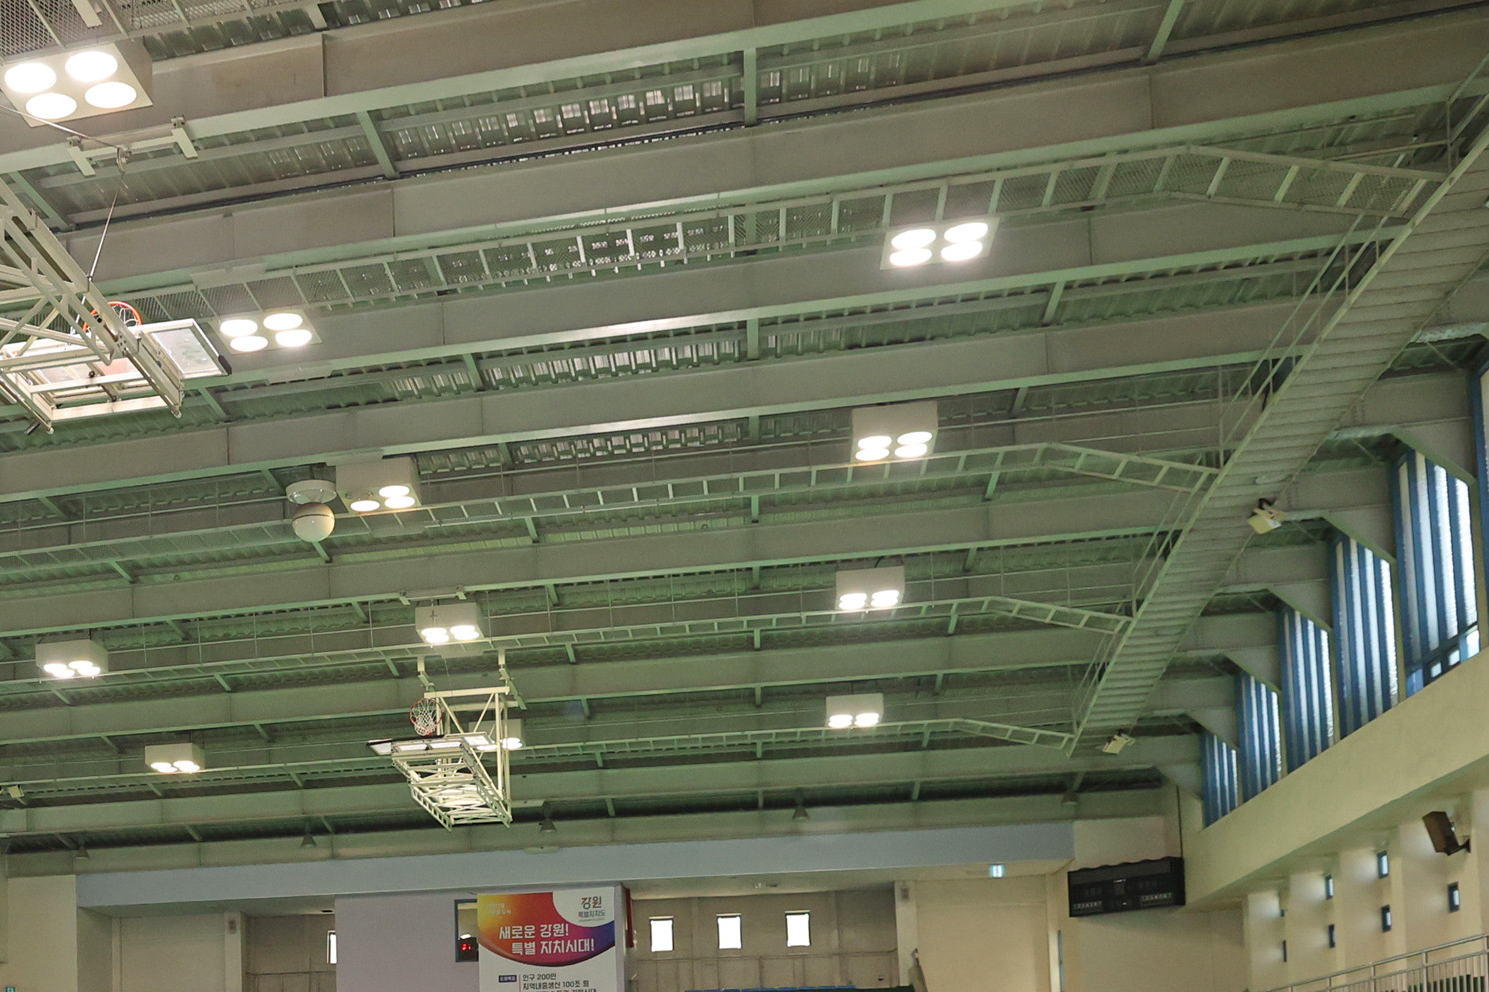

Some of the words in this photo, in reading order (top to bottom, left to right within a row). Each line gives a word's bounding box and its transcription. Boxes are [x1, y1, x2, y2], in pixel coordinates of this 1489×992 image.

[581, 895, 602, 910] 강원
[578, 909, 606, 918] 특별자치도
[499, 924, 536, 939] 새로운
[540, 922, 569, 938] 강원!
[512, 941, 536, 955] 특별
[540, 938, 595, 955] 자치시대!
